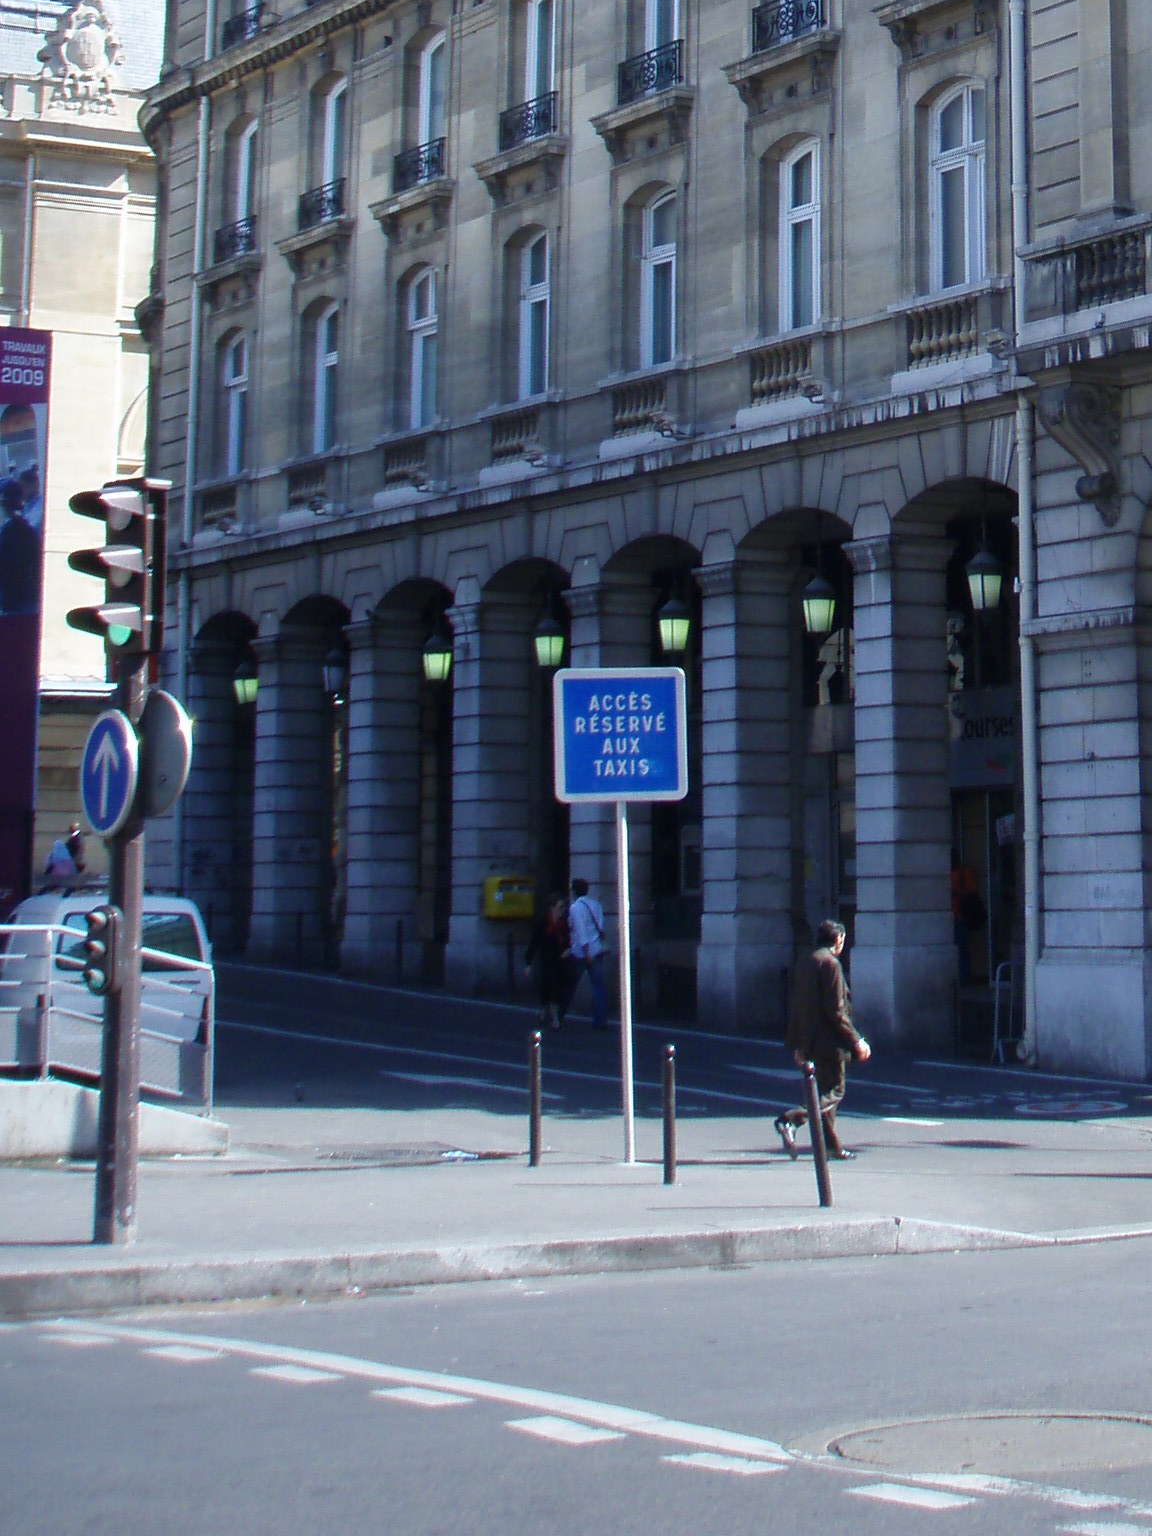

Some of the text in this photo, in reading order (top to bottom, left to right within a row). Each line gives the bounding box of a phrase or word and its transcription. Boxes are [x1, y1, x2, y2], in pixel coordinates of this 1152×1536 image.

[2, 340, 46, 354] TRAVAUX
[2, 367, 44, 386] 2009
[588, 690, 652, 712] ACCÈS
[574, 712, 667, 734] RÉSERVÉ
[602, 737, 640, 755] AUX
[593, 758, 650, 777] TAXIS
